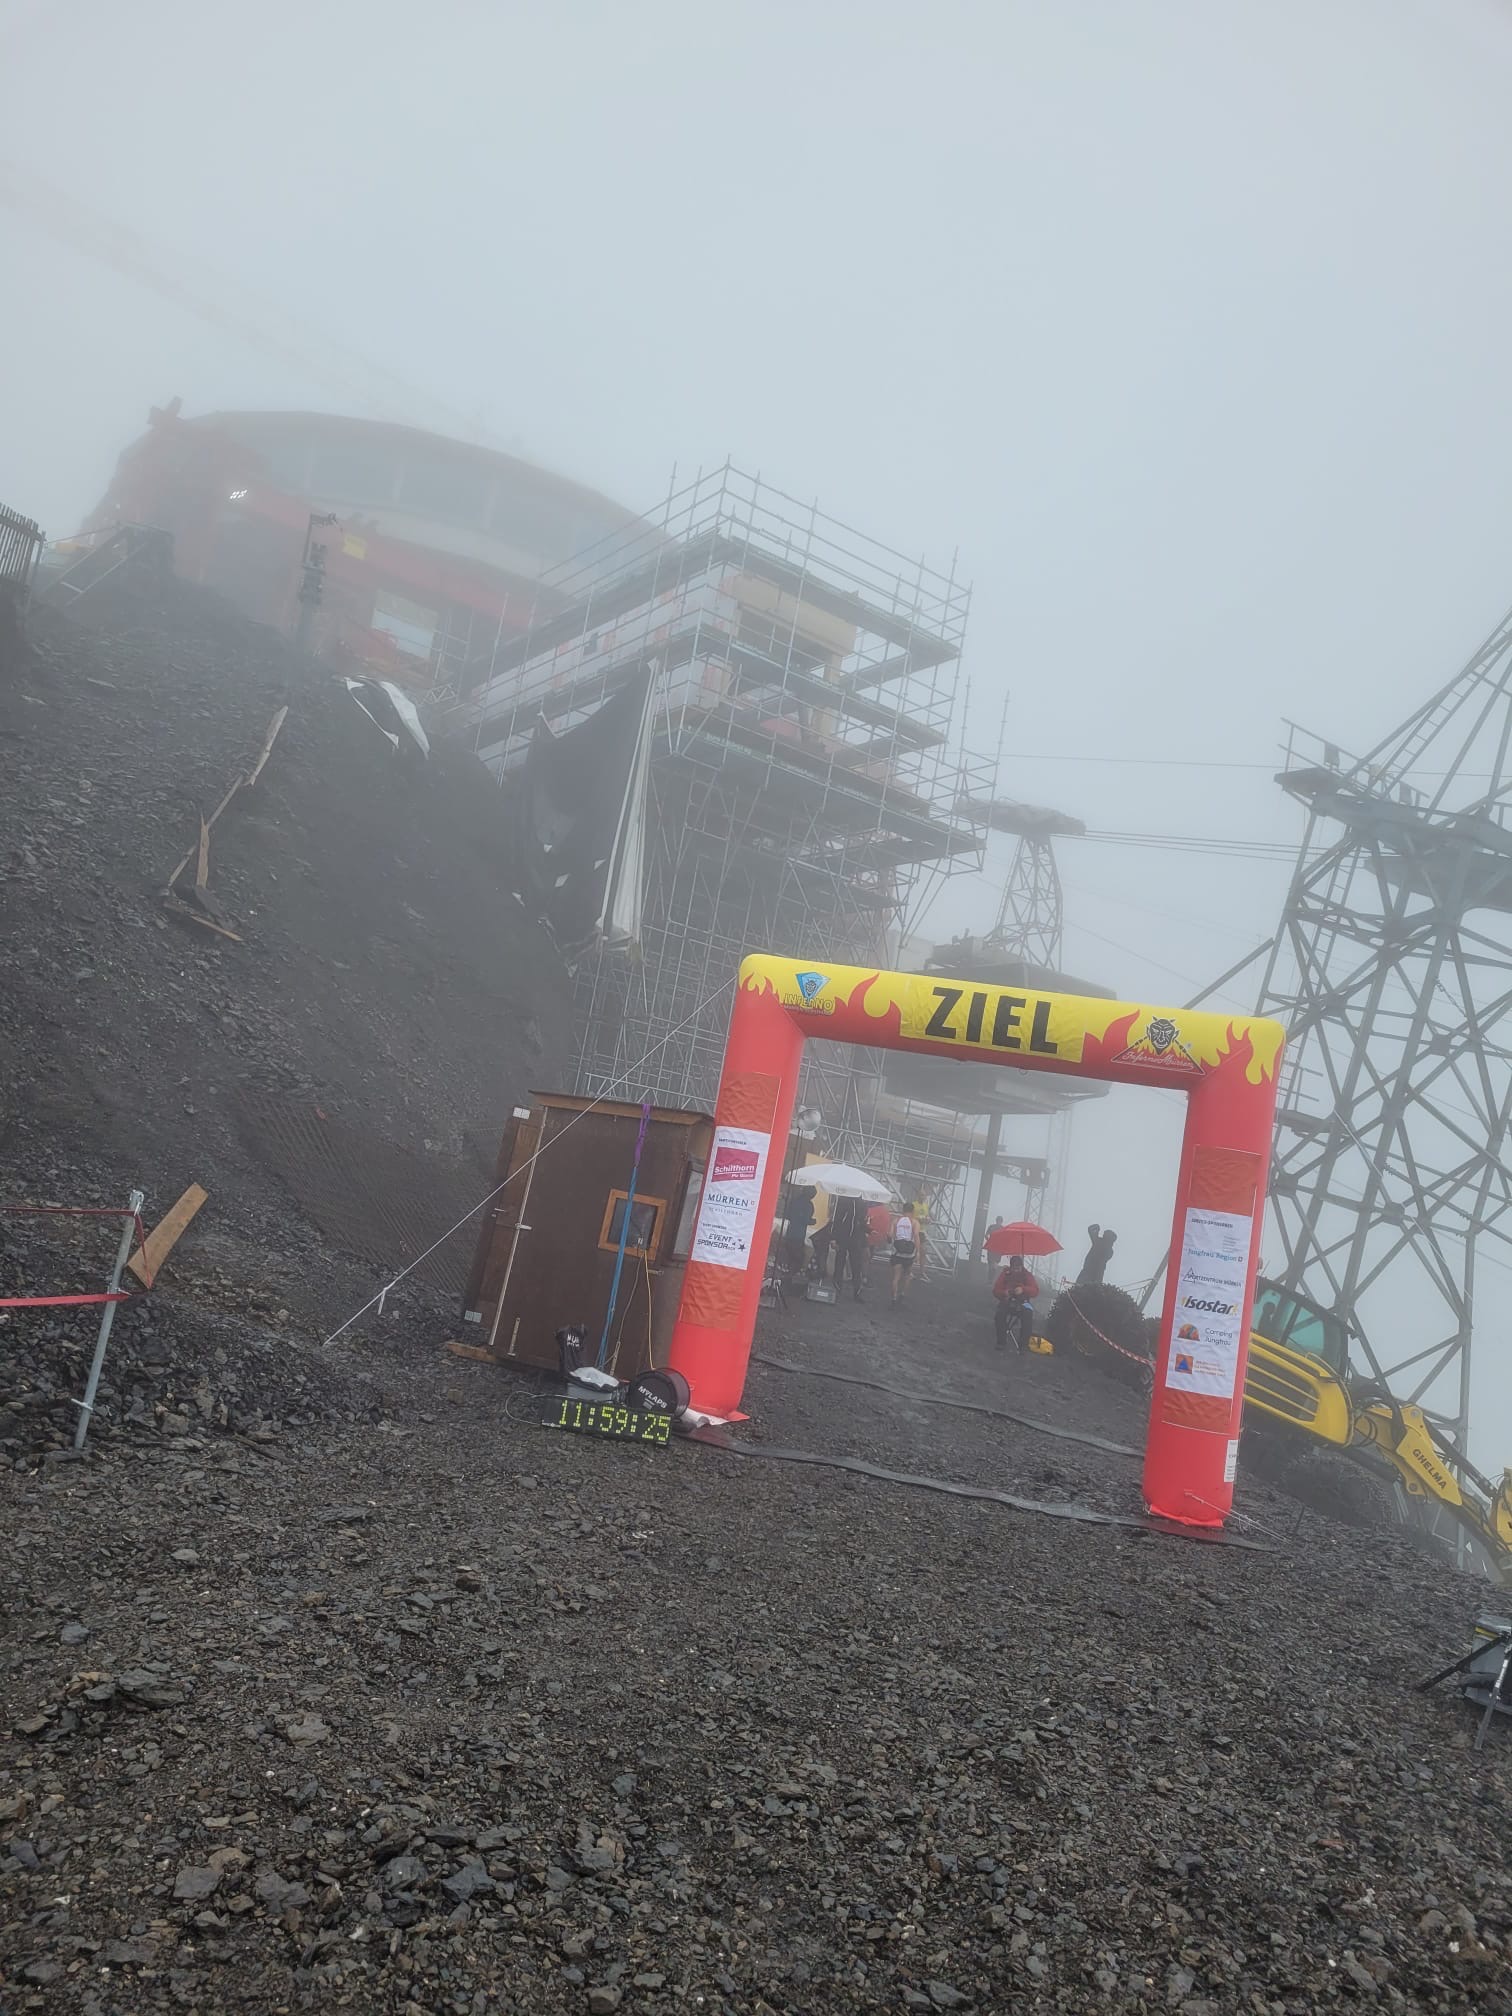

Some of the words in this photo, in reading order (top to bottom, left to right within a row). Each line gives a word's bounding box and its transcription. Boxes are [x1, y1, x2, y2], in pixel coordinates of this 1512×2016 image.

[925, 986, 1058, 1054] ZIEL
[715, 1164, 755, 1174] Schilthorn
[708, 1193, 749, 1208] MÜRREN
[708, 1233, 733, 1243] EVENT
[1187, 1248, 1214, 1259] Jungfrau
[1215, 1252, 1237, 1262] Region
[1184, 1296, 1234, 1315] isostar
[1205, 1327, 1233, 1338] Camping
[1205, 1336, 1231, 1346] Jungfrau
[637, 1385, 668, 1410] MYLAPS
[559, 1400, 672, 1442] 11:59:25
[1412, 1448, 1448, 1490] GHELMA
